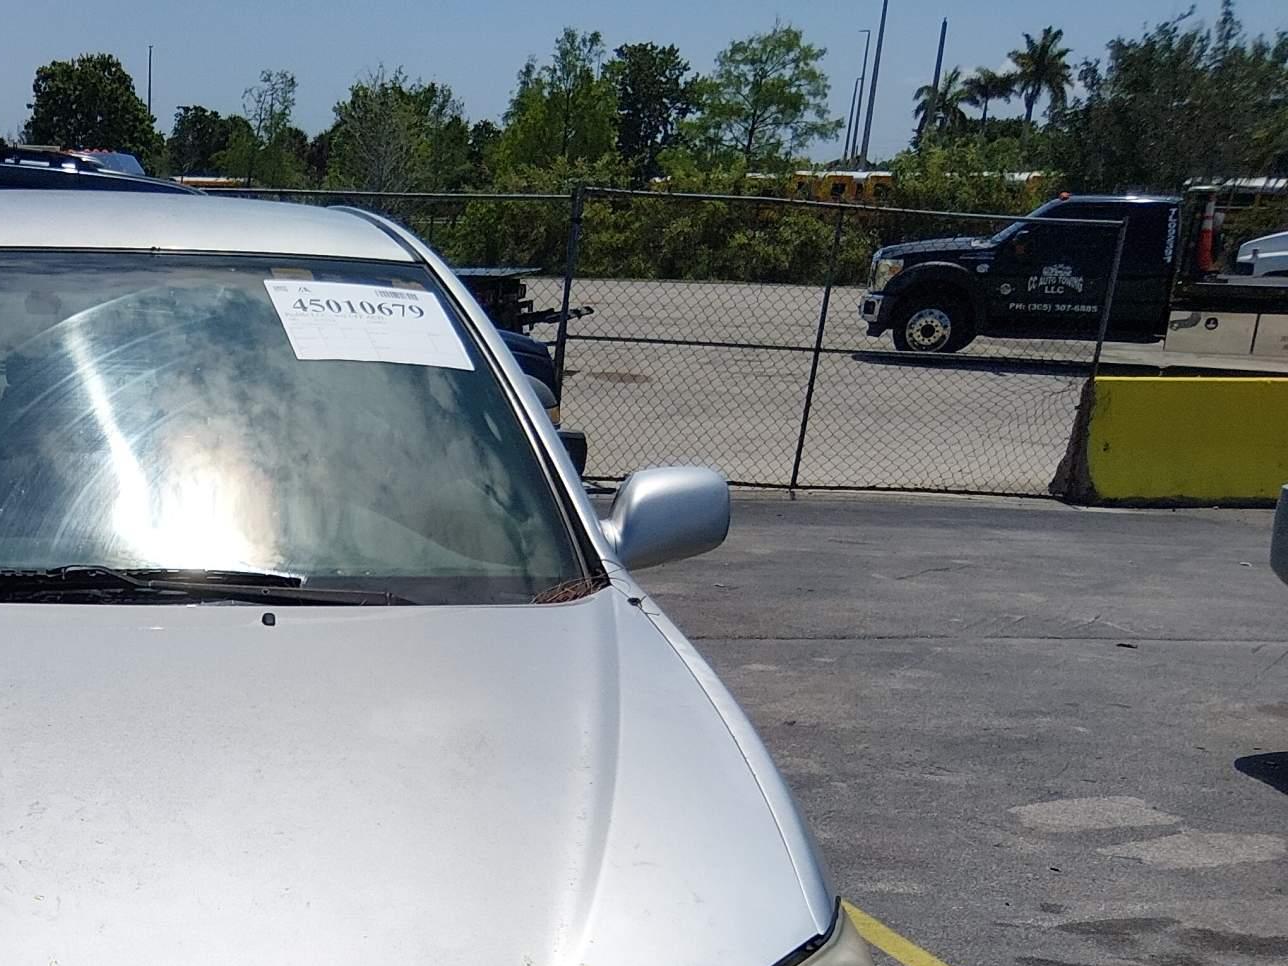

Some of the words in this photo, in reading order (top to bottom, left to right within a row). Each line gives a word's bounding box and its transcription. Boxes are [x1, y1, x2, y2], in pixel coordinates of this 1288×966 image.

[1027, 276, 1038, 292] CC
[1038, 276, 1057, 287] AUTO
[1057, 276, 1085, 293] TOWING
[1044, 286, 1065, 294] LLC
[292, 297, 425, 319] 45010679
